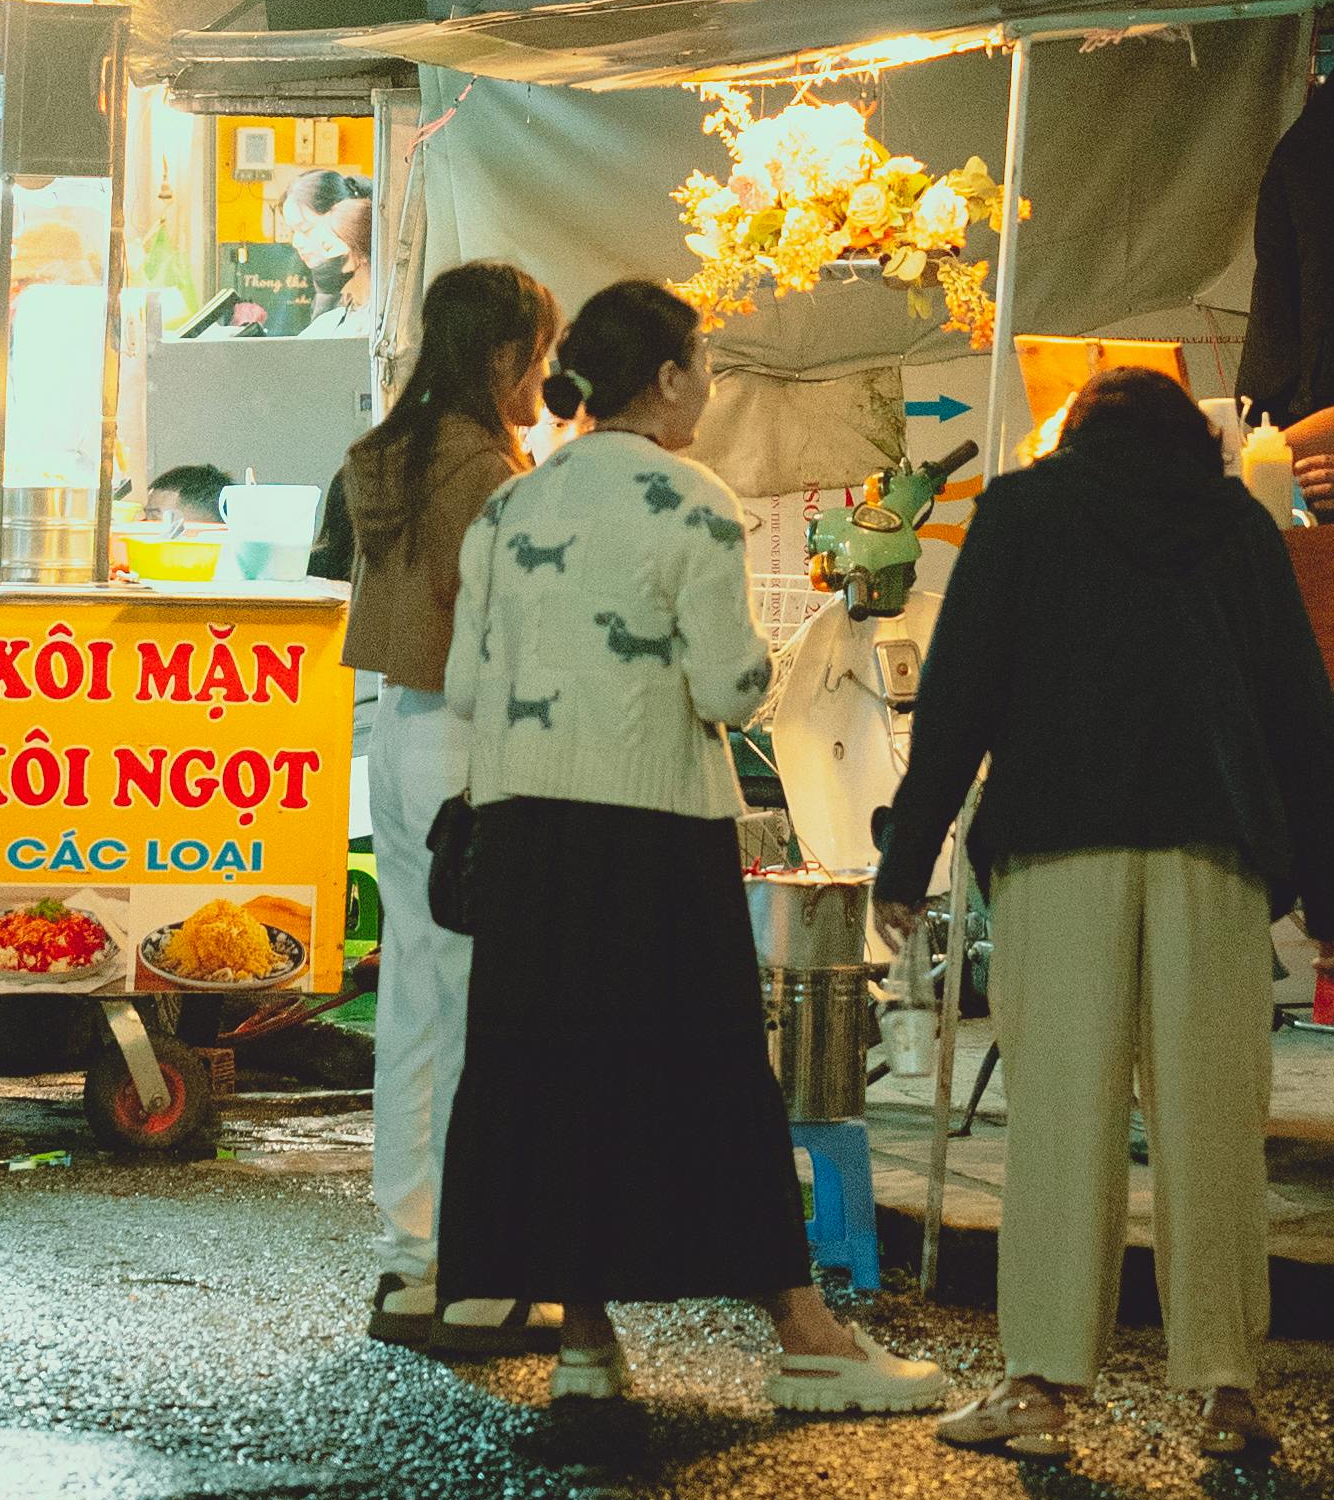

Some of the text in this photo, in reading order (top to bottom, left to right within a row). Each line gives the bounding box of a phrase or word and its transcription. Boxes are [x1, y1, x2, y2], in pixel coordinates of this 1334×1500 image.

[135, 623, 306, 720] MẶN
[113, 747, 320, 826] NGỌT
[7, 830, 262, 881] CÁC LOẠI
